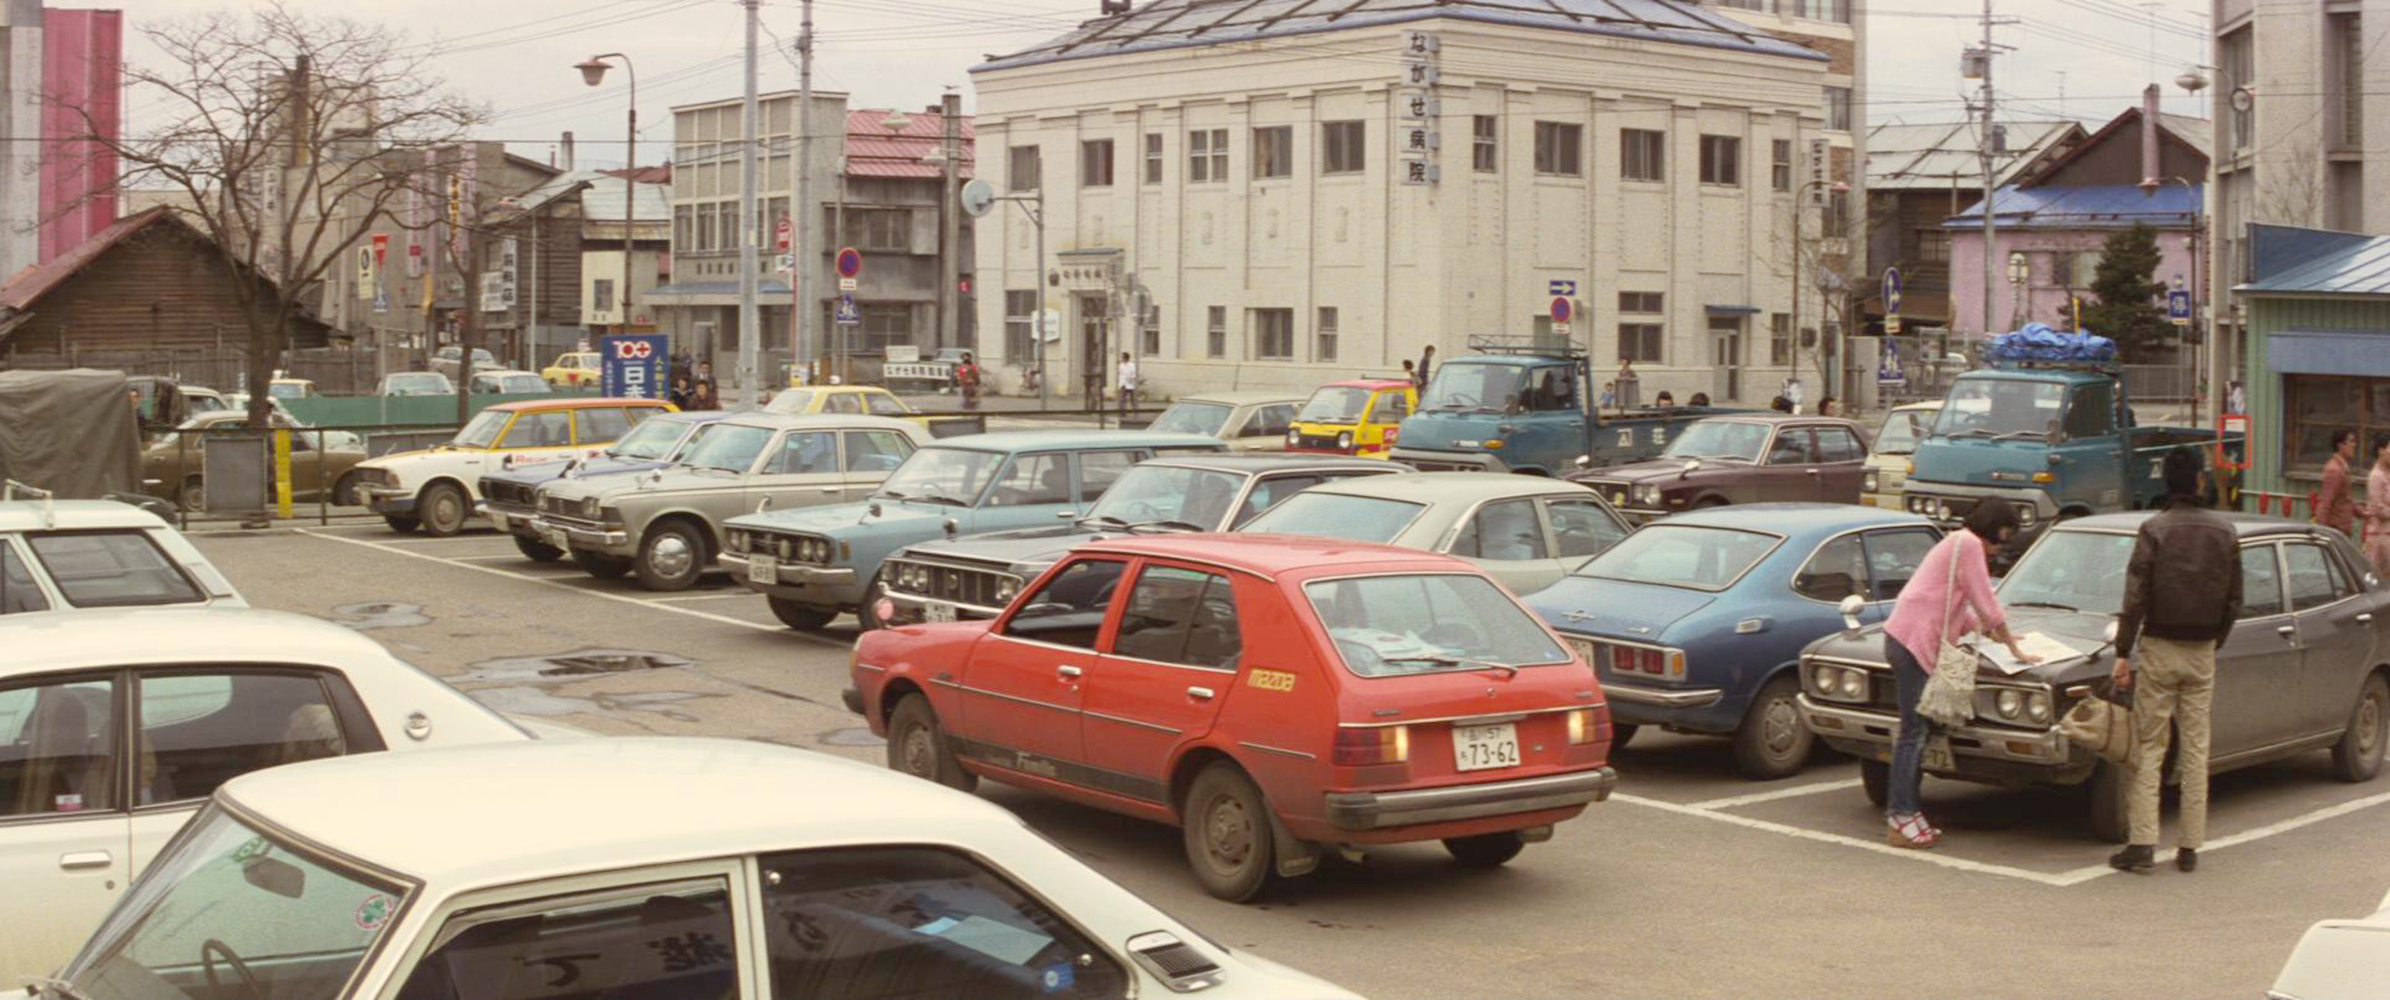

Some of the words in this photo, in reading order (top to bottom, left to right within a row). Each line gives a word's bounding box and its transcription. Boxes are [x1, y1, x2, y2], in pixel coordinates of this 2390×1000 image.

[1409, 32, 1425, 182] ながせ病院
[1469, 741, 1517, 765] 73-62
